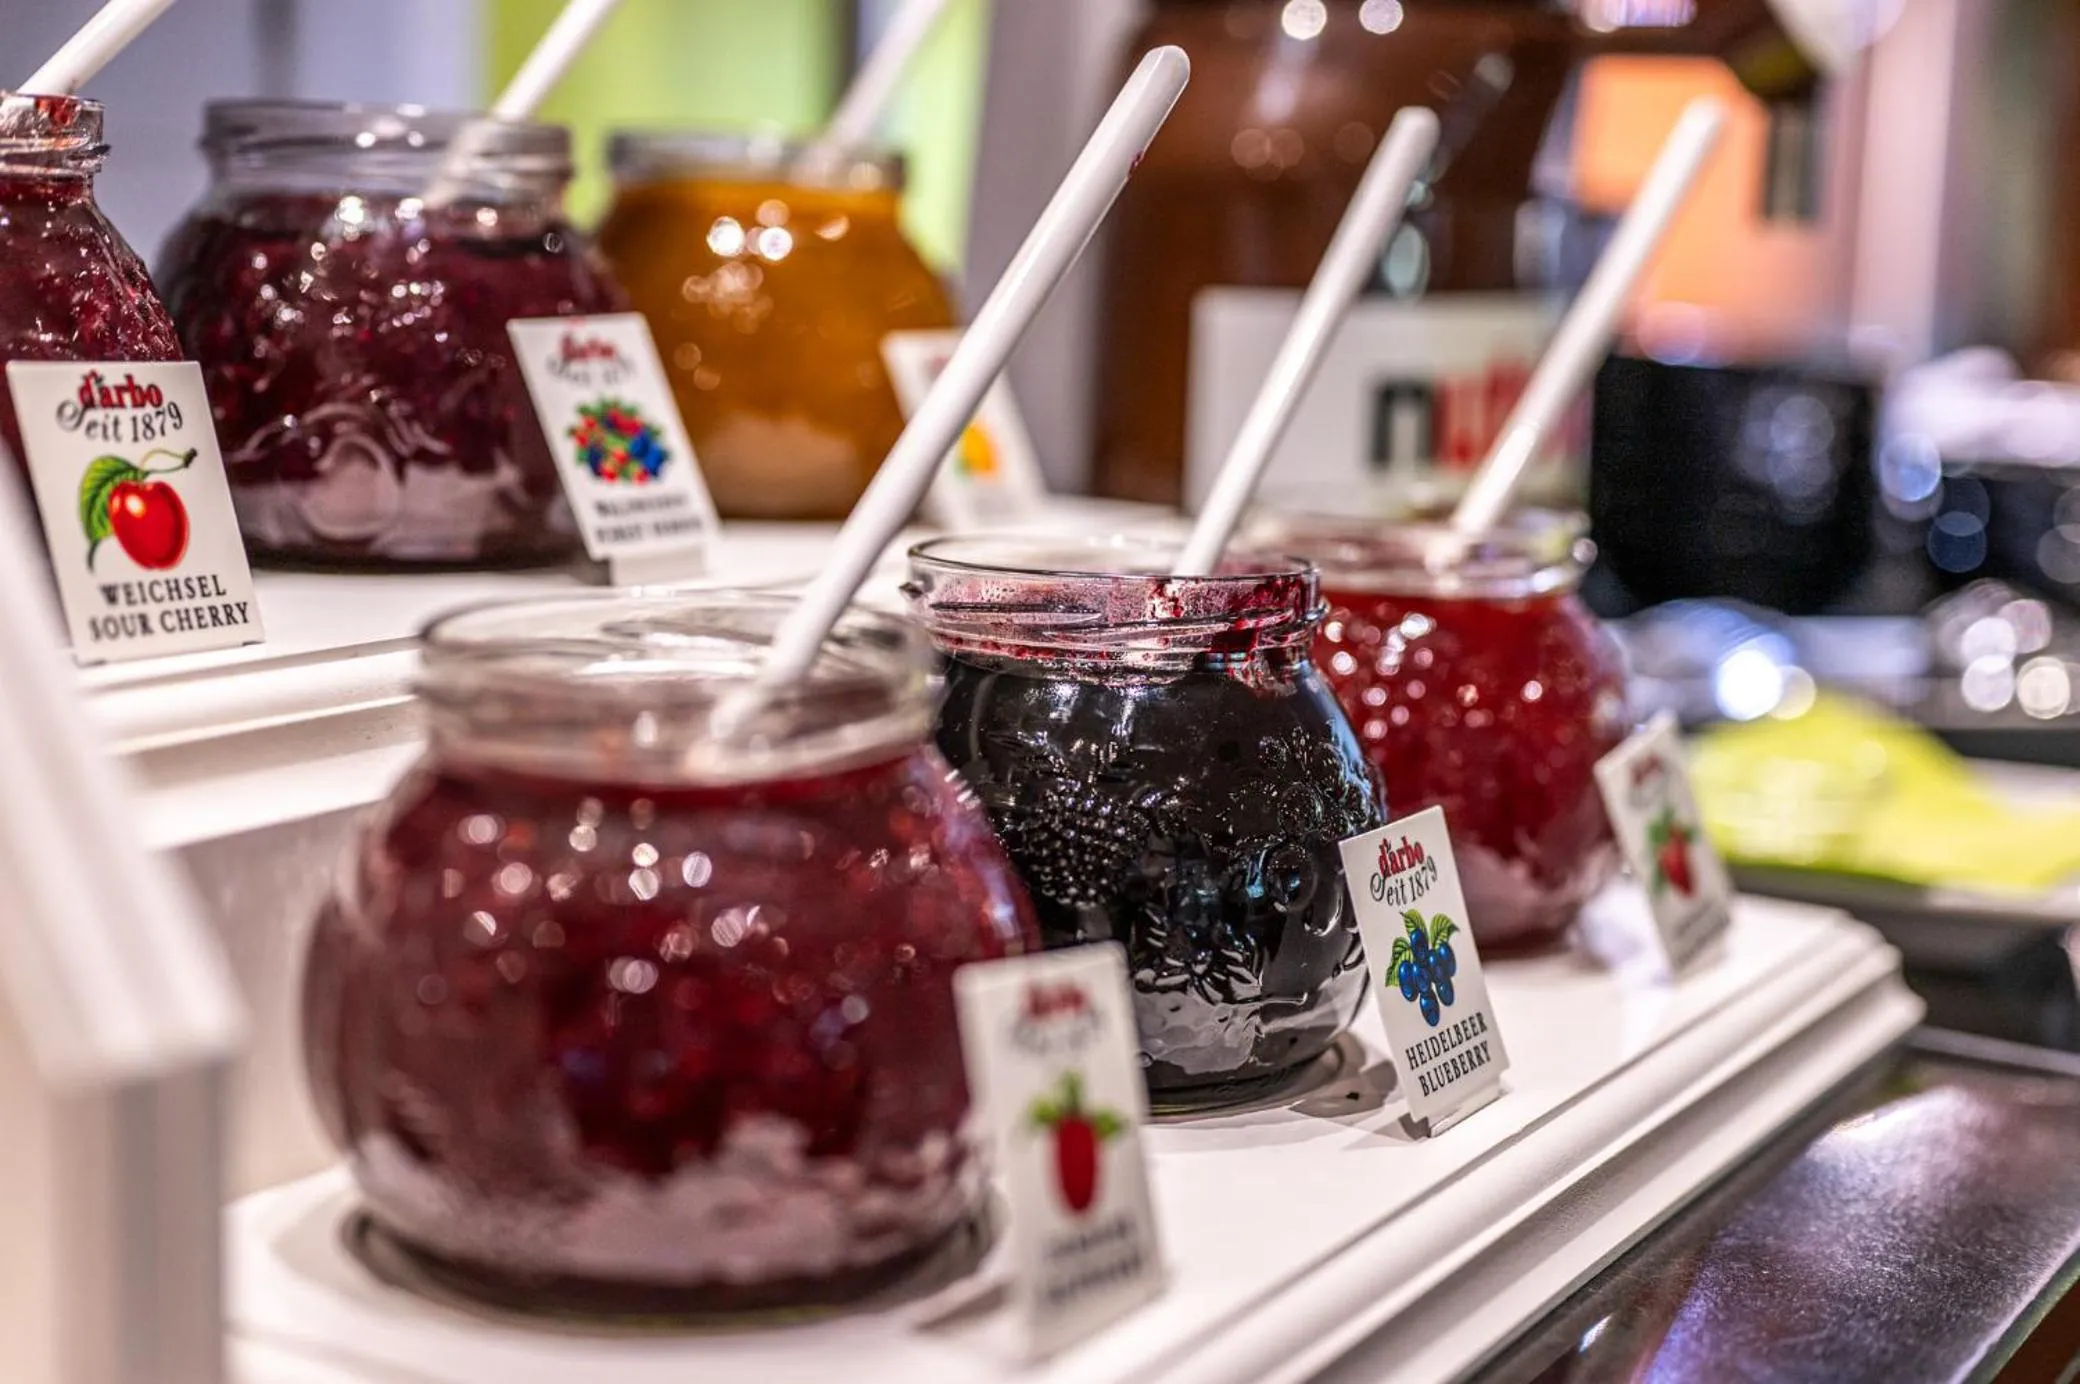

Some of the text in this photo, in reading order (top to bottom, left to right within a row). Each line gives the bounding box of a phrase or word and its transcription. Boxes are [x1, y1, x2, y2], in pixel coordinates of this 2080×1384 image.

[56, 399, 184, 443] Seit 1879
[99, 573, 227, 608] WEICHSEL
[89, 601, 251, 642] SOUR CHERRY
[1370, 855, 1438, 906] Seit 1879
[1405, 1012, 1488, 1071] HEIDELBEER
[1418, 1040, 1492, 1098] BLUEBERRY
